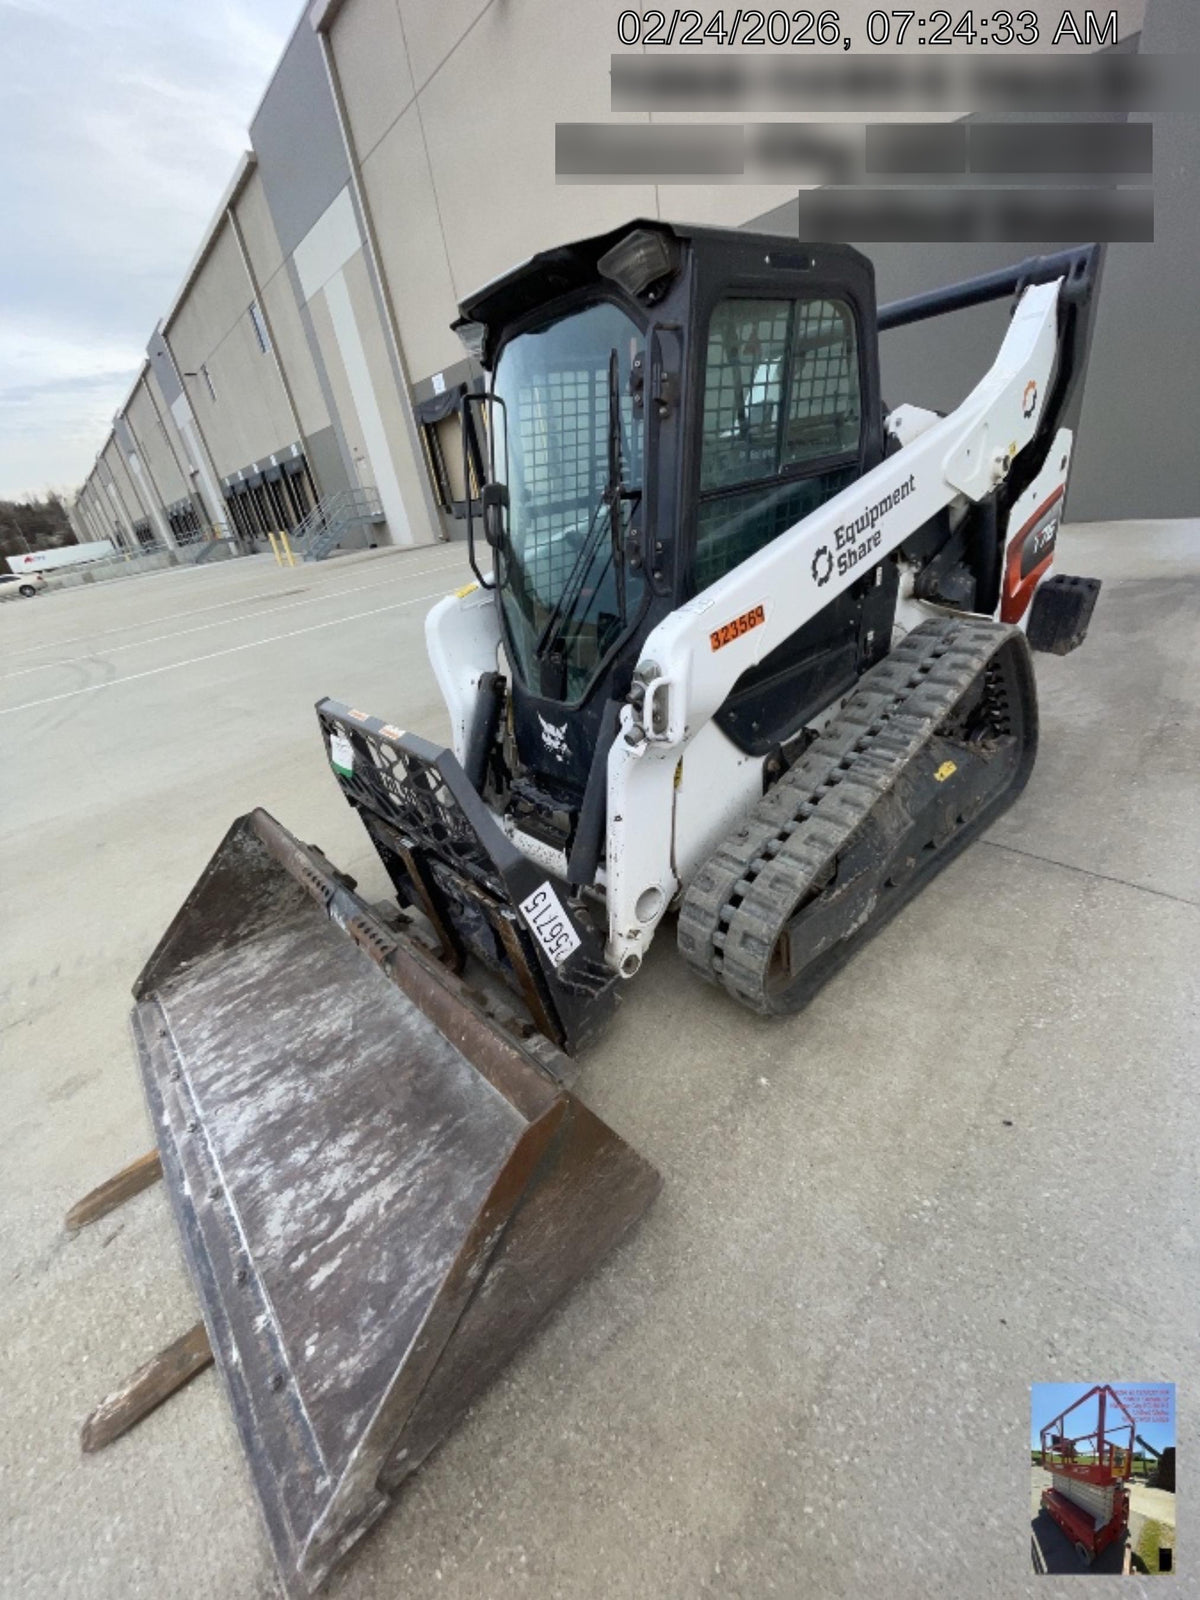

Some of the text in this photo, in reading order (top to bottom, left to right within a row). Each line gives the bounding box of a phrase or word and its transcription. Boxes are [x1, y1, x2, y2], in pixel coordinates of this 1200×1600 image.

[834, 474, 916, 551] Equipment
[837, 530, 882, 576] Share
[710, 604, 765, 651] 323569
